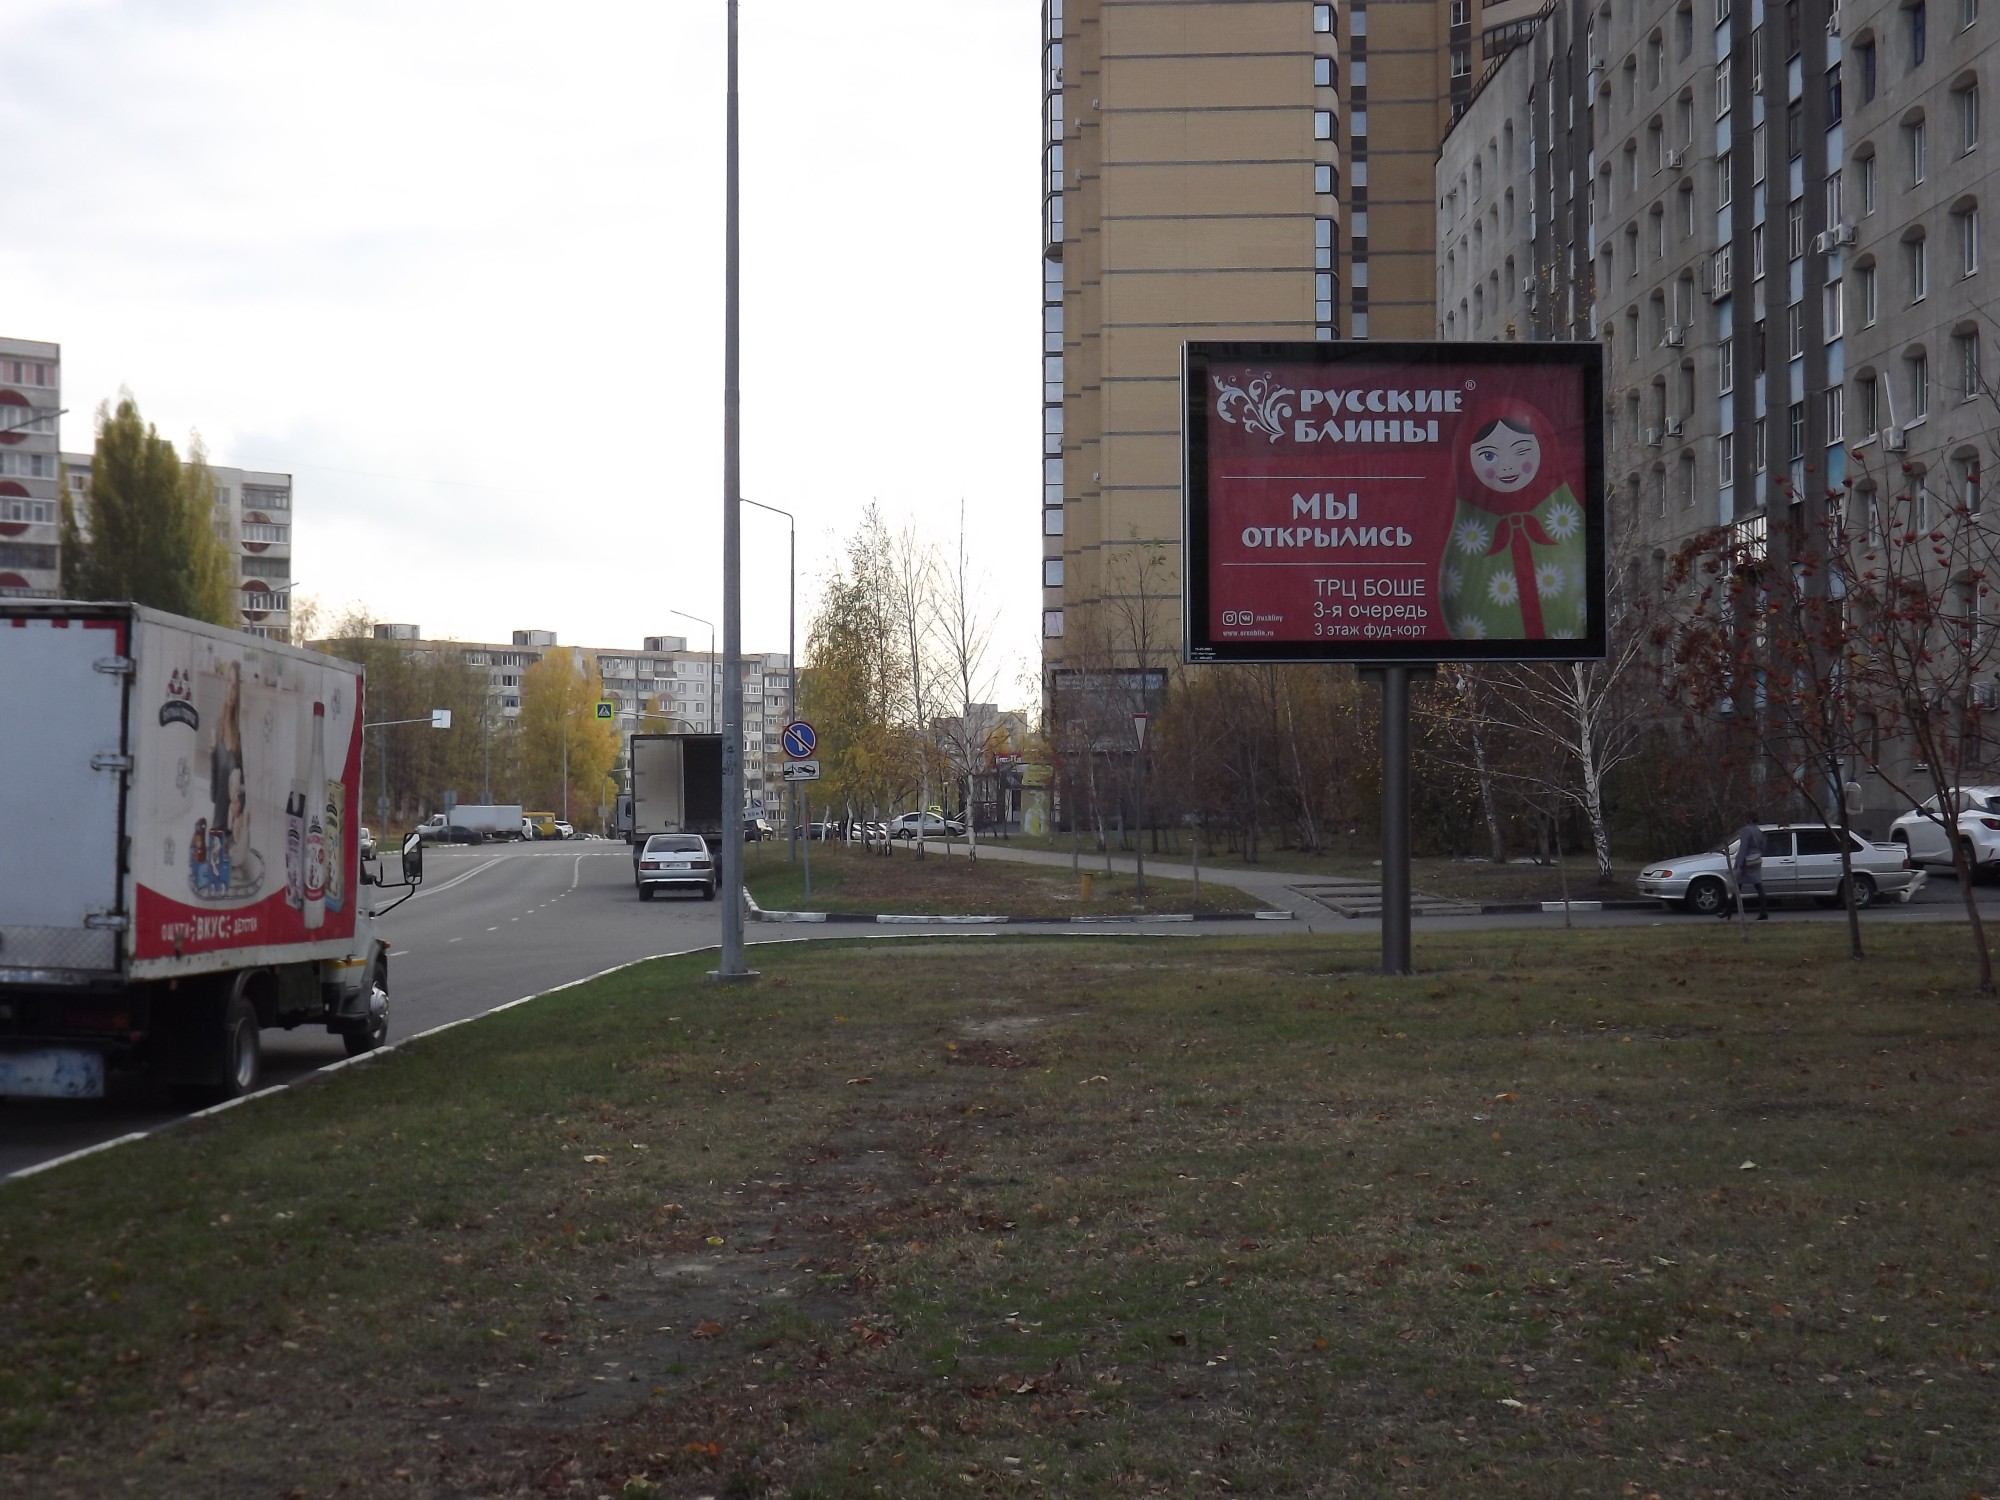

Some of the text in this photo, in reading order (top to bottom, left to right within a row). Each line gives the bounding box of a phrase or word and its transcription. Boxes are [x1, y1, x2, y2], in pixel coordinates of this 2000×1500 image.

[1300, 389, 1463, 417] РУССКИЕ
[1294, 419, 1440, 443] БЛИНЫ
[1292, 492, 1358, 520] МЫ
[1241, 526, 1413, 548] ОТКРЫЛИСЬ
[1313, 578, 1426, 600] ТРЦ БОШЕ
[1313, 601, 1428, 621] 3-я очередь
[1313, 622, 1428, 639] 3 этаж фуд-корт
